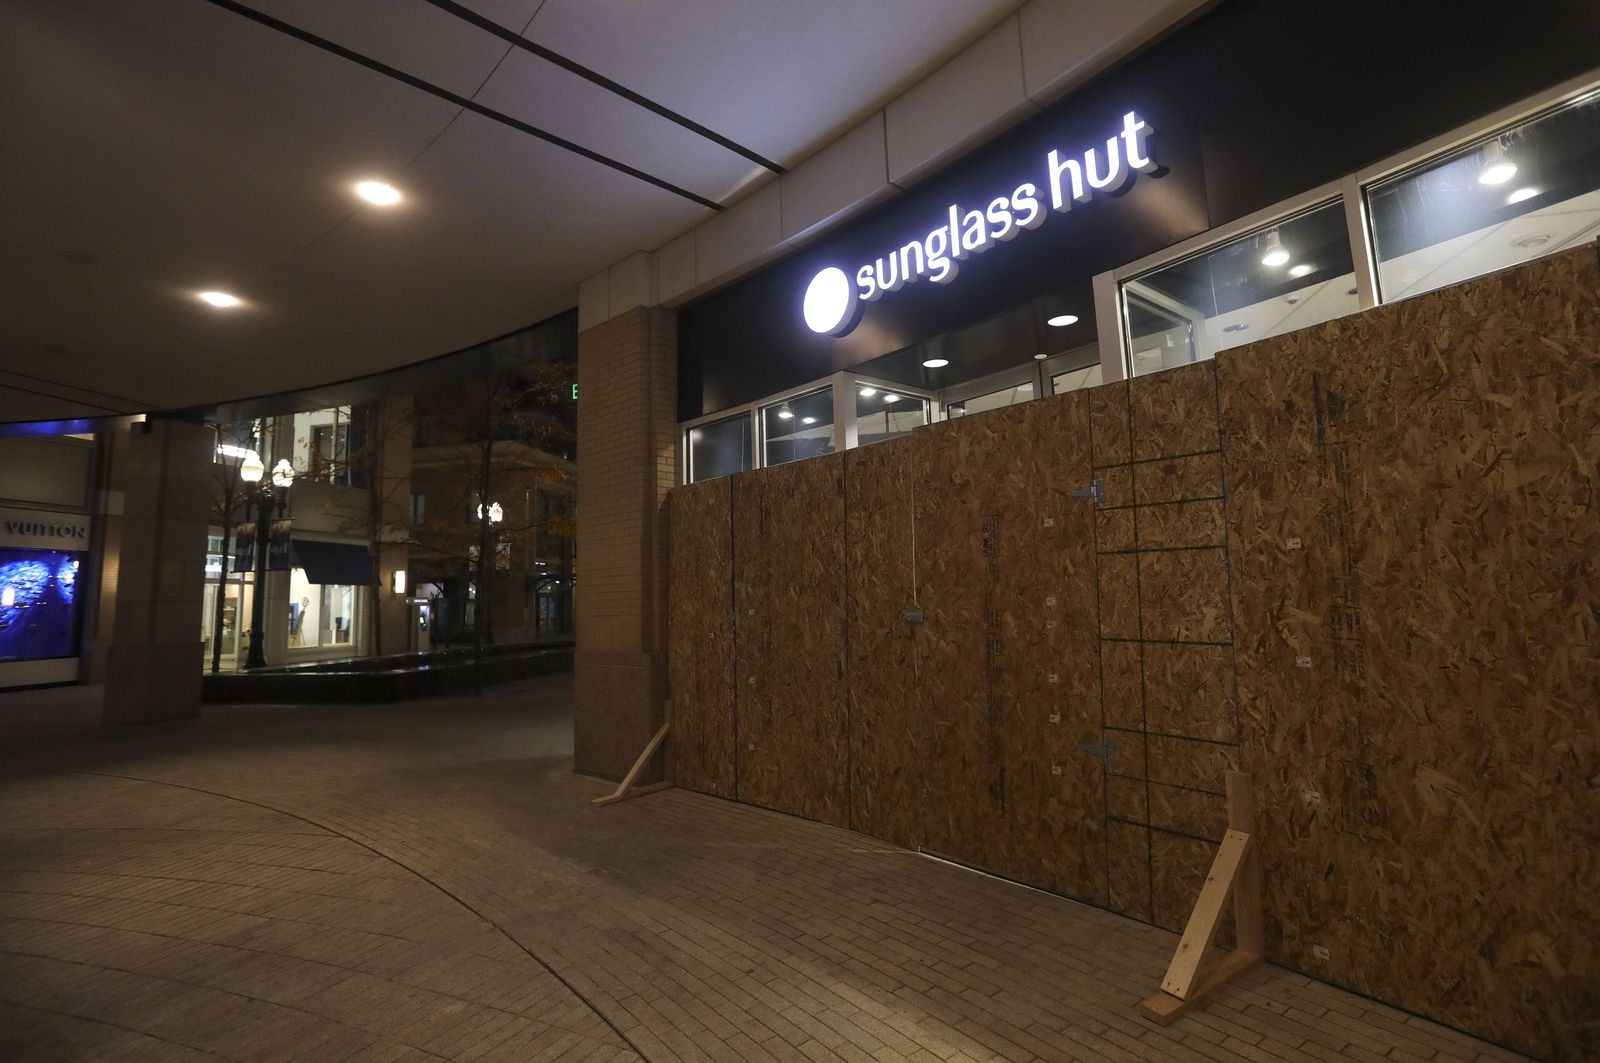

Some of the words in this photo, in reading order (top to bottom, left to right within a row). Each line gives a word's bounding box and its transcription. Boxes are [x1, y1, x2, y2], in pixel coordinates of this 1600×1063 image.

[856, 182, 1041, 301] sunglass
[1047, 110, 1152, 210] hut
[5, 520, 86, 538] VUITTON
